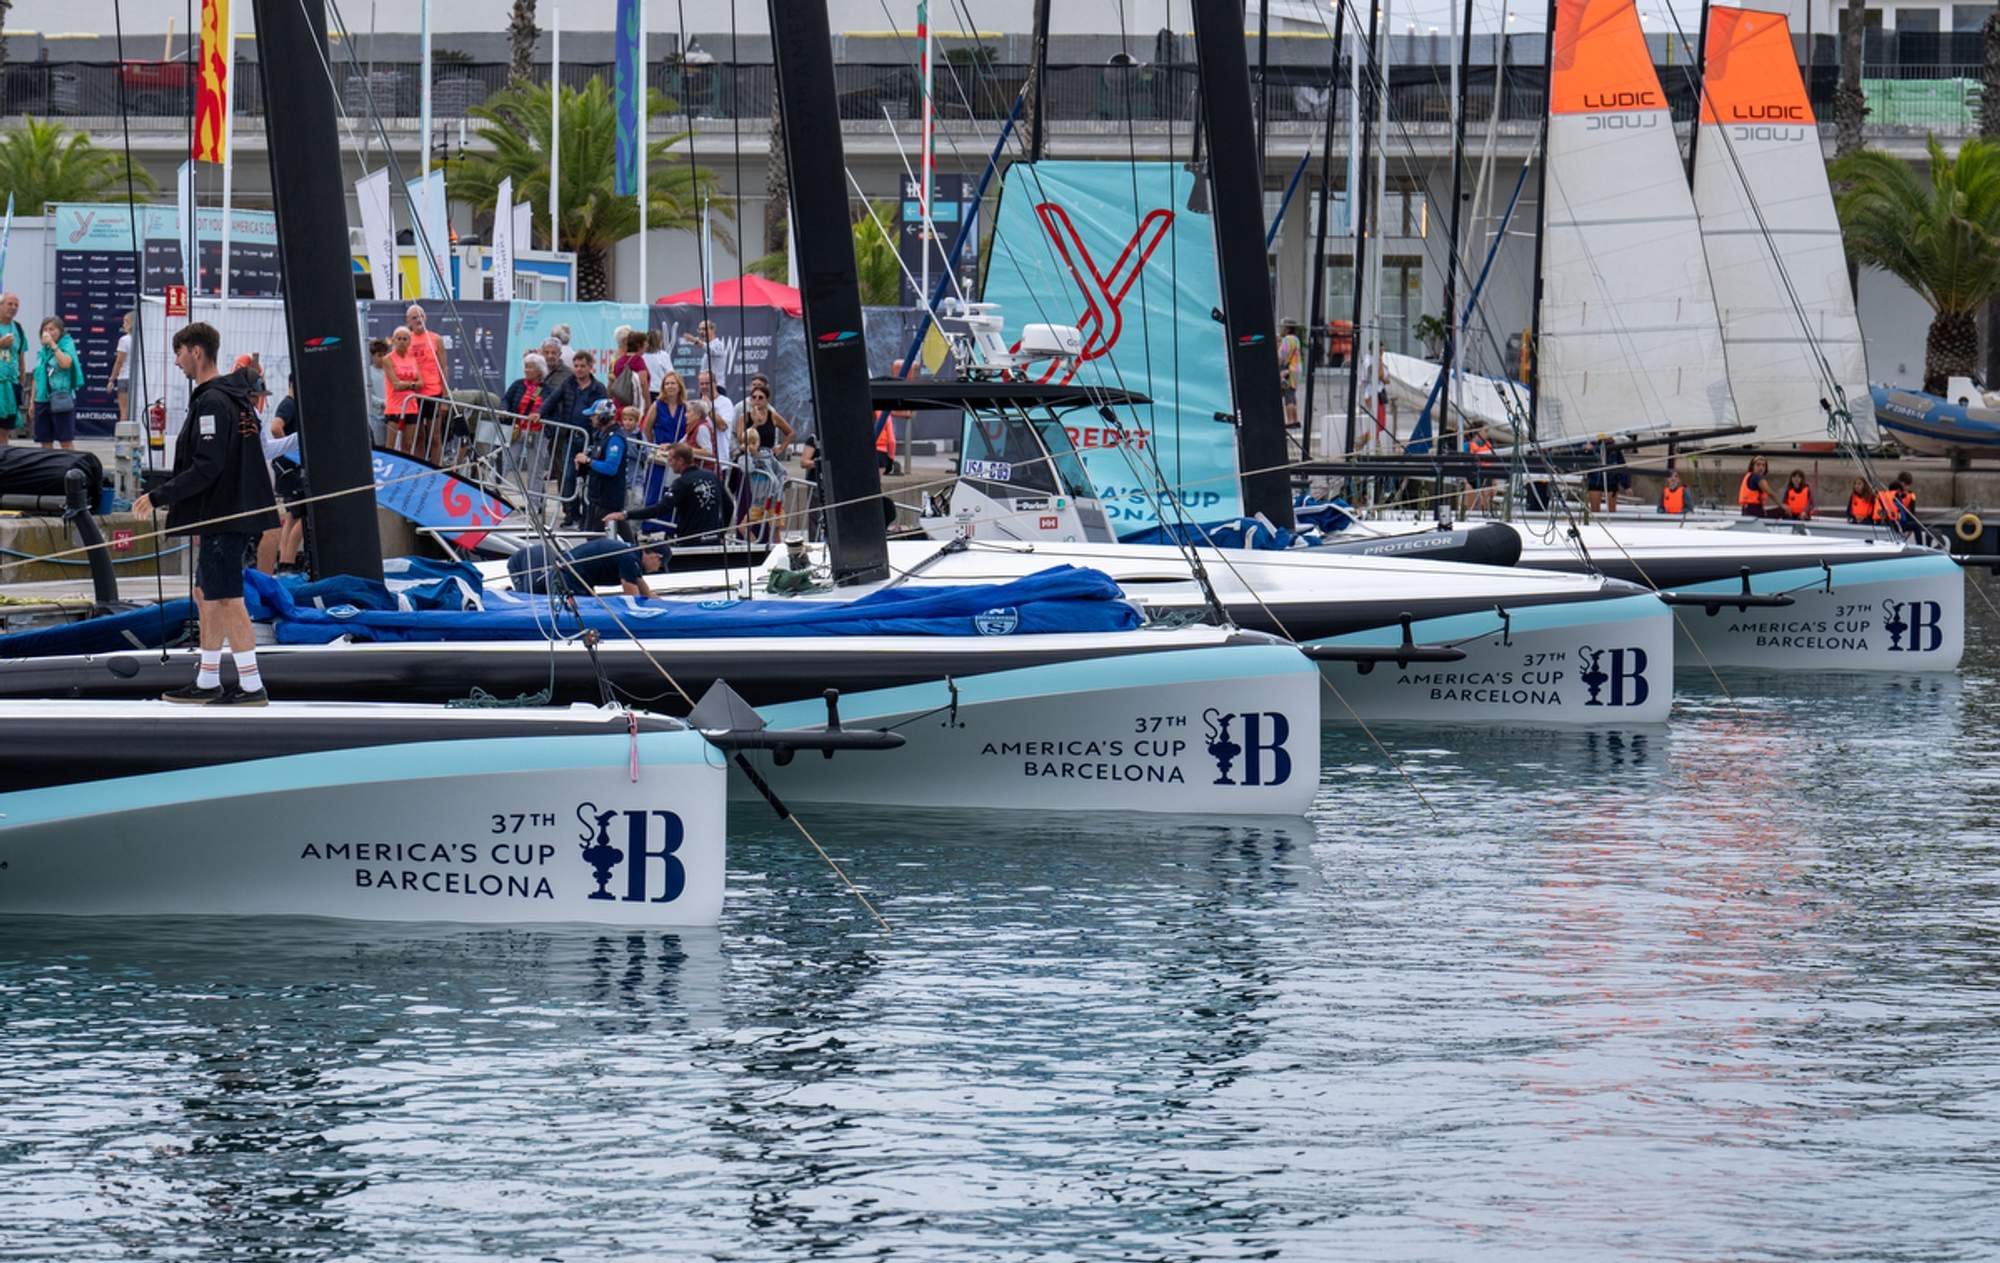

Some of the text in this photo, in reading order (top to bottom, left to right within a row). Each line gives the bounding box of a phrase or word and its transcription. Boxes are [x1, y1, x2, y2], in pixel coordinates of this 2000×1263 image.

[1584, 92, 1656, 108] LUDIC
[1733, 105, 1803, 120] LUDIC
[76, 411, 118, 420] BARCELONA
[1064, 426, 1152, 450] REDIT
[965, 460, 984, 478] USA
[1157, 490, 1221, 509] CUP
[1363, 537, 1453, 556] PROTECTOR
[1835, 604, 1872, 617] 37TH
[1728, 620, 1870, 633] AMERICA'S CUP
[1756, 636, 1869, 650] BARCELONA
[1523, 652, 1566, 667] 37TH
[1397, 671, 1564, 685] AMERICA'S CUP
[1430, 688, 1562, 705] BARCELONA
[1135, 715, 1187, 733] 37TH
[981, 740, 1186, 757] AMERICA'S CUP
[1024, 762, 1185, 784] BARCELONA
[491, 813, 556, 834] 37TH
[301, 842, 555, 865] AMERICA'S CUP
[356, 868, 555, 900] BARCELONA
